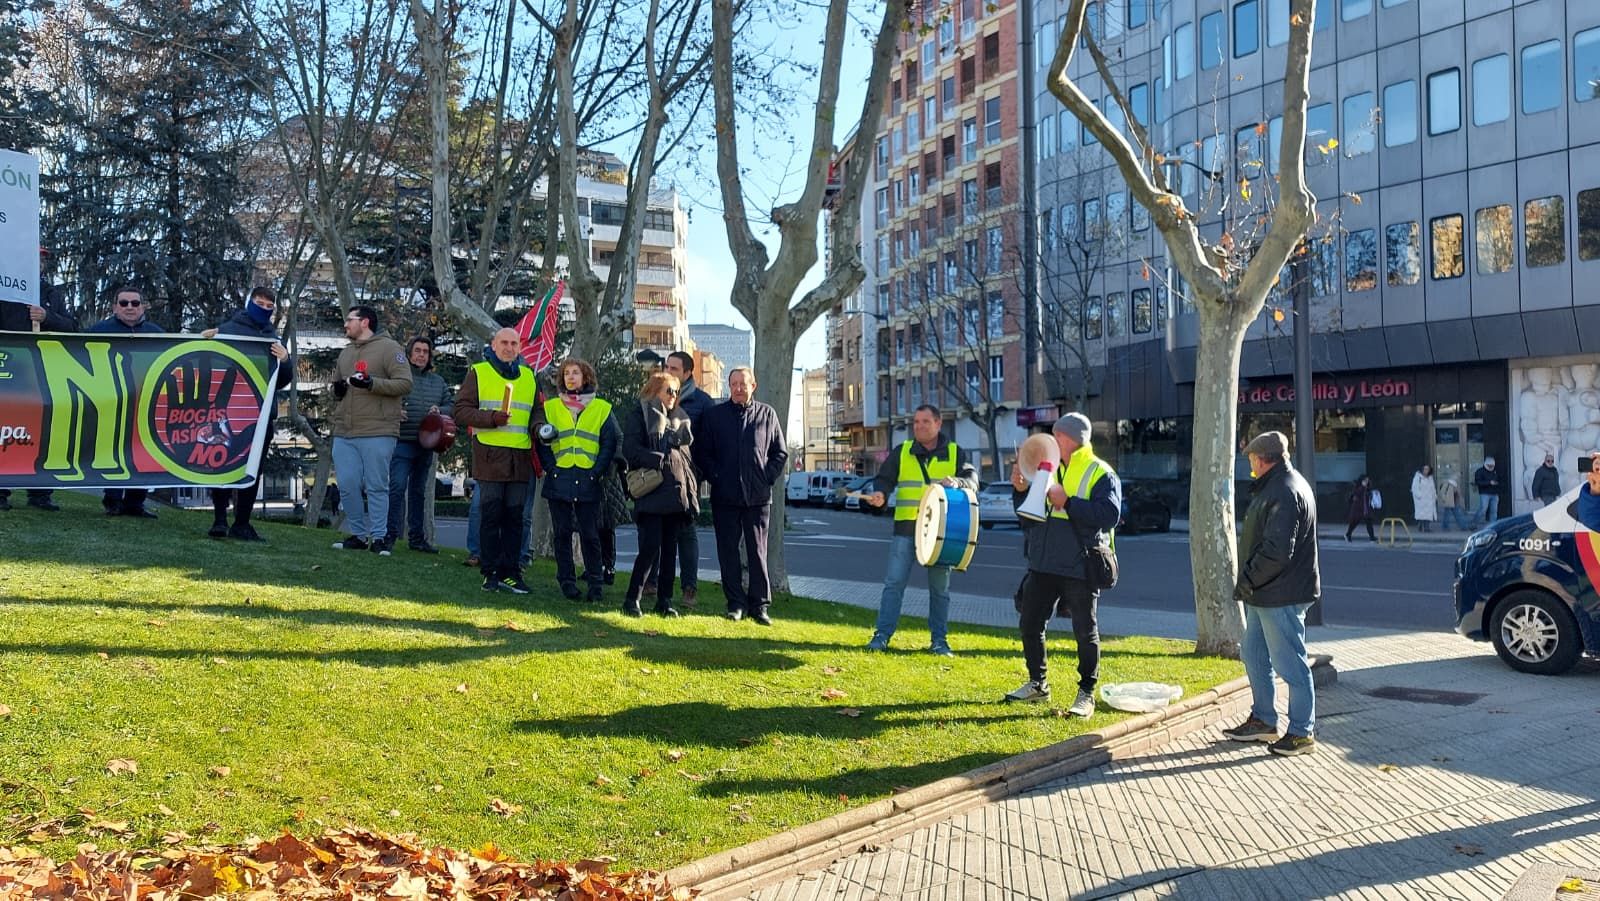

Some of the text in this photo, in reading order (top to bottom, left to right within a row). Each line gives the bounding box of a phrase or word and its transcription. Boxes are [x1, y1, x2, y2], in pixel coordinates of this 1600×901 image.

[0, 165, 32, 191] ÓN
[1251, 388, 1271, 402] de
[1276, 384, 1338, 401] Cailla
[1343, 386, 1355, 404] y
[1360, 379, 1409, 397] León
[168, 403, 226, 424] BIOGÁS
[187, 443, 228, 468] NO
